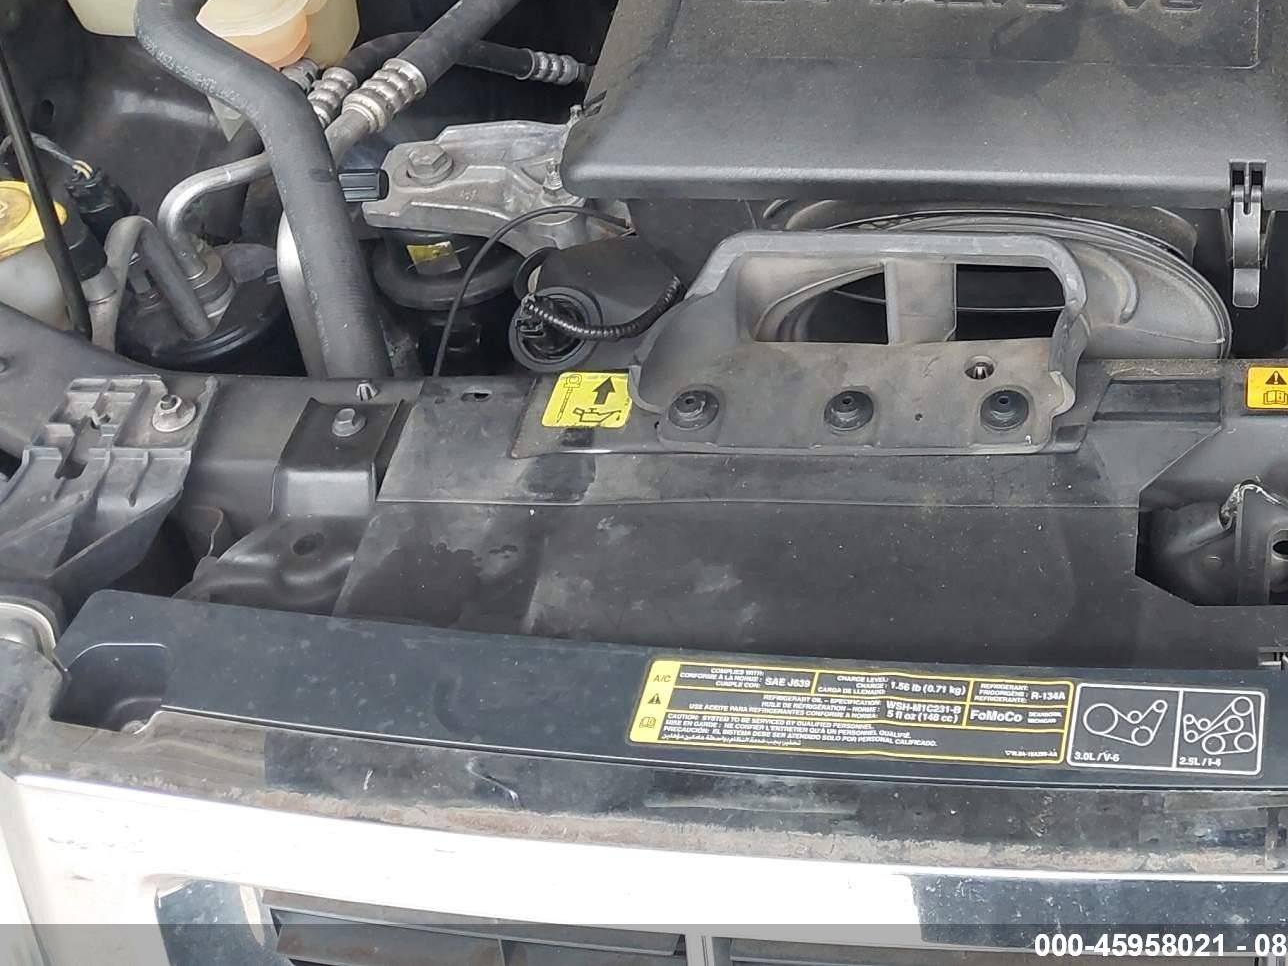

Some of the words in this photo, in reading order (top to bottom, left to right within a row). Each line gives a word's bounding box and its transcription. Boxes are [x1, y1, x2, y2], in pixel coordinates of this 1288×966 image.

[680, 672, 717, 680] CONFORME
[711, 667, 745, 675] COMPLIES
[653, 674, 672, 683] A/C
[765, 677, 786, 687] SAE
[787, 678, 811, 688] J639
[836, 675, 866, 683] CHARGE
[891, 681, 910, 692] 1.56
[911, 683, 921, 692] lb
[922, 683, 946, 694] (0.71
[949, 685, 966, 696] kg)
[980, 683, 1029, 691] REFRIGERANT:
[1031, 691, 1066, 701] R-134A
[703, 704, 729, 712] ACEITE
[729, 705, 748, 713] PARA
[749, 706, 805, 716] REFRIGERANTES
[806, 709, 844, 718] CONFORME
[886, 700, 962, 714] WSH-M1C231-B
[667, 713, 699, 721] CAUTION:
[752, 718, 785, 726] SERVICED
[887, 709, 894, 718] 5
[895, 711, 903, 719] fl
[904, 713, 917, 721] oz
[917, 712, 940, 722] (148
[941, 714, 959, 724] cc)
[970, 709, 1023, 723] FoMoCo
[735, 723, 764, 731] CONFIER
[838, 729, 878, 737] PERSONNEL
[787, 733, 821, 741] ATENDIDO
[857, 736, 894, 744] PERSONAL
[895, 738, 938, 747] CALIFICADO.
[1074, 750, 1096, 761] 3.0L
[1103, 752, 1120, 762] V-6
[1179, 756, 1201, 766] 2.5L
[1207, 758, 1222, 767] I-4
